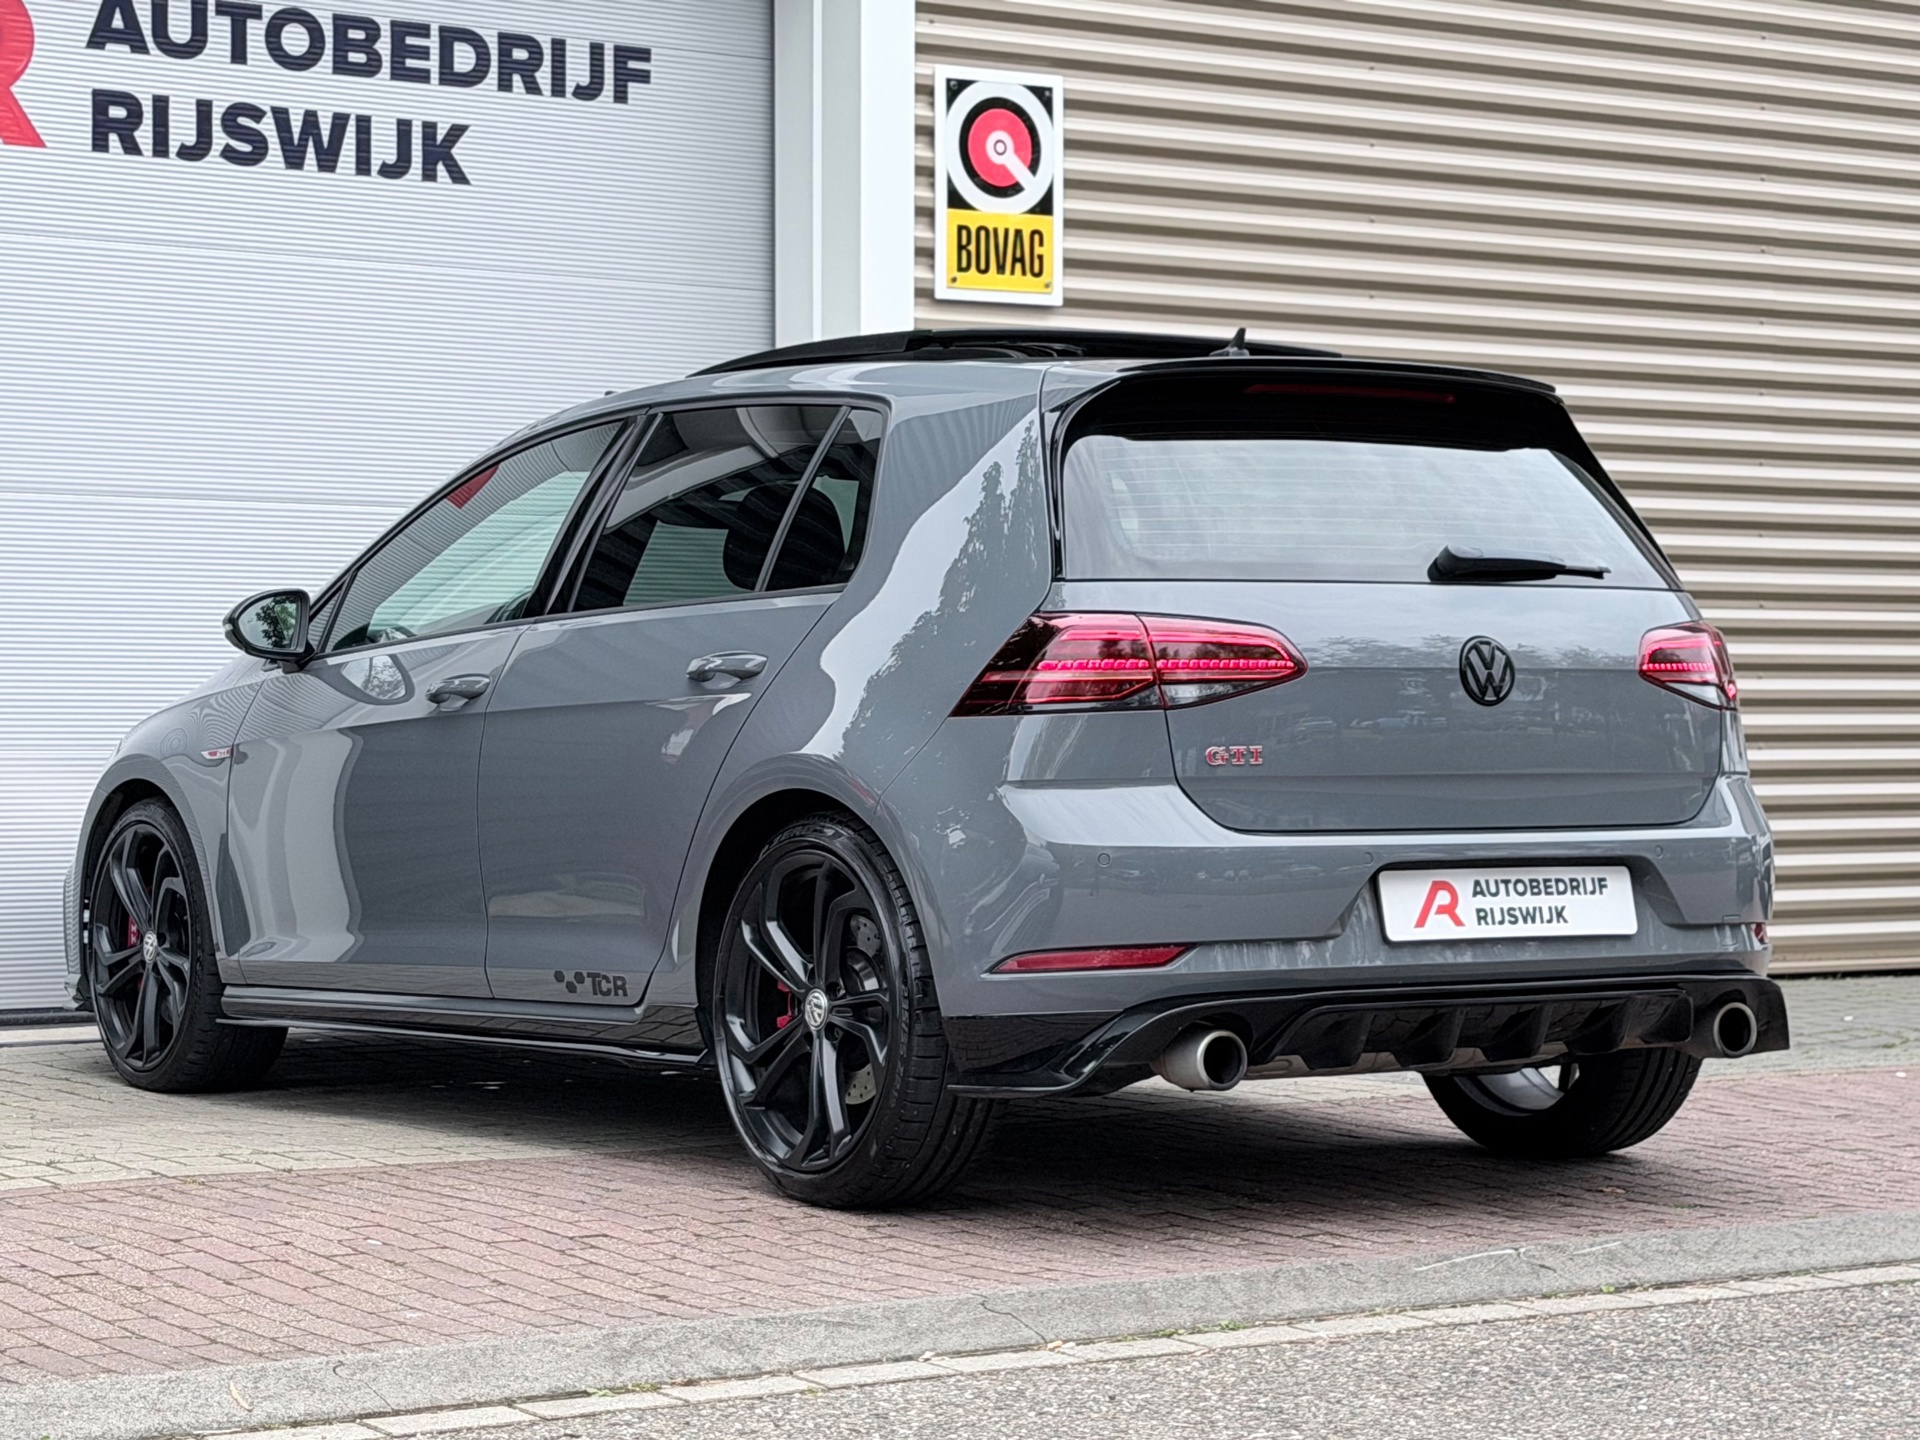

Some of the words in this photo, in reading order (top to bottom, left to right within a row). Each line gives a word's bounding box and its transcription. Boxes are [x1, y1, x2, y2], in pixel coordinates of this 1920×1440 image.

[86, 0, 652, 104] AUTOBEDRIJF
[91, 88, 472, 185] RIJSWIJK
[956, 224, 1045, 278] BOVAG
[1205, 745, 1263, 766] GTI
[1471, 877, 1608, 898] AUTOBEDRIJF
[1475, 906, 1569, 926] RIJSWIJK
[586, 971, 628, 997] TCR
